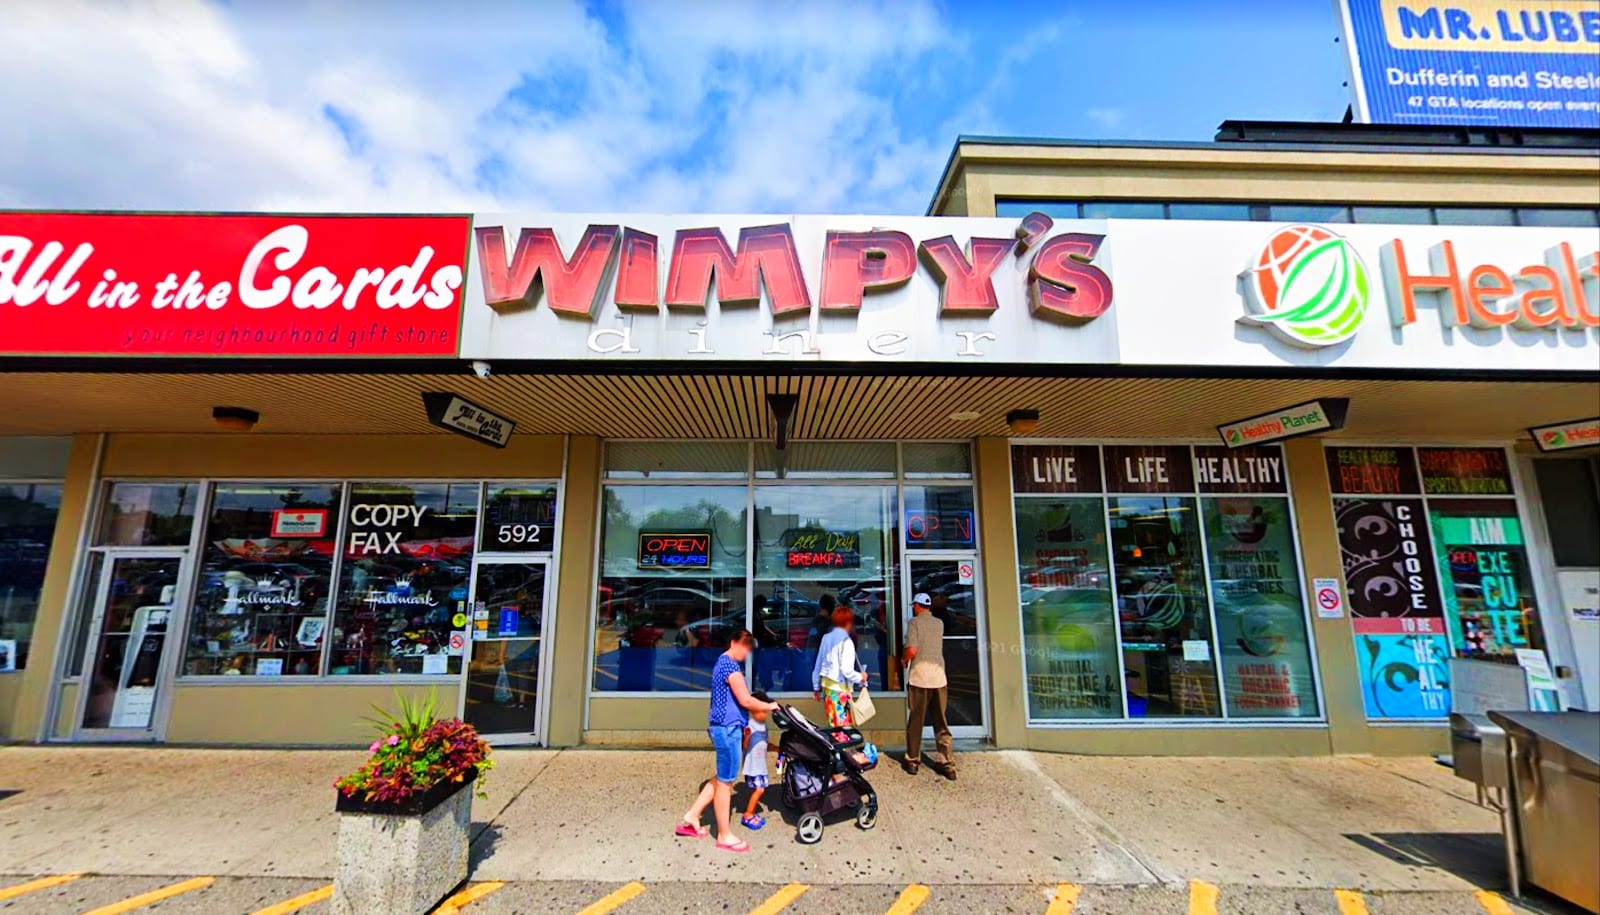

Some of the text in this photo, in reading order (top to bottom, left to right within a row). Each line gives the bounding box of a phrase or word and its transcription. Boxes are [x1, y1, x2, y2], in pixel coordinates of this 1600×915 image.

[1397, 6, 1491, 40] MR.
[1386, 67, 1600, 90] Dufferin and Steel
[1407, 95, 1600, 113] 47 GTA locations open ever
[87, 268, 140, 309] in
[151, 270, 232, 309] the
[238, 224, 463, 310] Cards
[474, 211, 1113, 326] WIMPY'S
[1380, 237, 1600, 328] Heal
[348, 322, 388, 350] gift
[395, 325, 448, 345] store
[587, 313, 995, 356] diner
[1240, 410, 1322, 439] Healthy Planet
[1195, 457, 1281, 484] HEALTHY
[1340, 464, 1401, 493] BEAUTY
[350, 503, 427, 528] COPY
[349, 531, 402, 555] FAX
[498, 524, 540, 543] 592
[646, 538, 706, 552] OPEN
[790, 532, 856, 552] All Day
[642, 555, 708, 565] 24 HOURS
[788, 552, 852, 567] BREAKFA
[1396, 505, 1428, 610] CHOOSE
[1477, 551, 1511, 573] EXE
[363, 584, 440, 611] Hallmark
[1482, 575, 1518, 608] CU
[1400, 618, 1433, 632] TO BE
[1487, 610, 1528, 646] TE
[1412, 639, 1437, 664] HE
[1048, 659, 1095, 674] NATURAL
[1419, 664, 1443, 690] AL
[1067, 674, 1100, 692] CARE
[1104, 674, 1116, 692] &
[1421, 691, 1445, 710] THY
